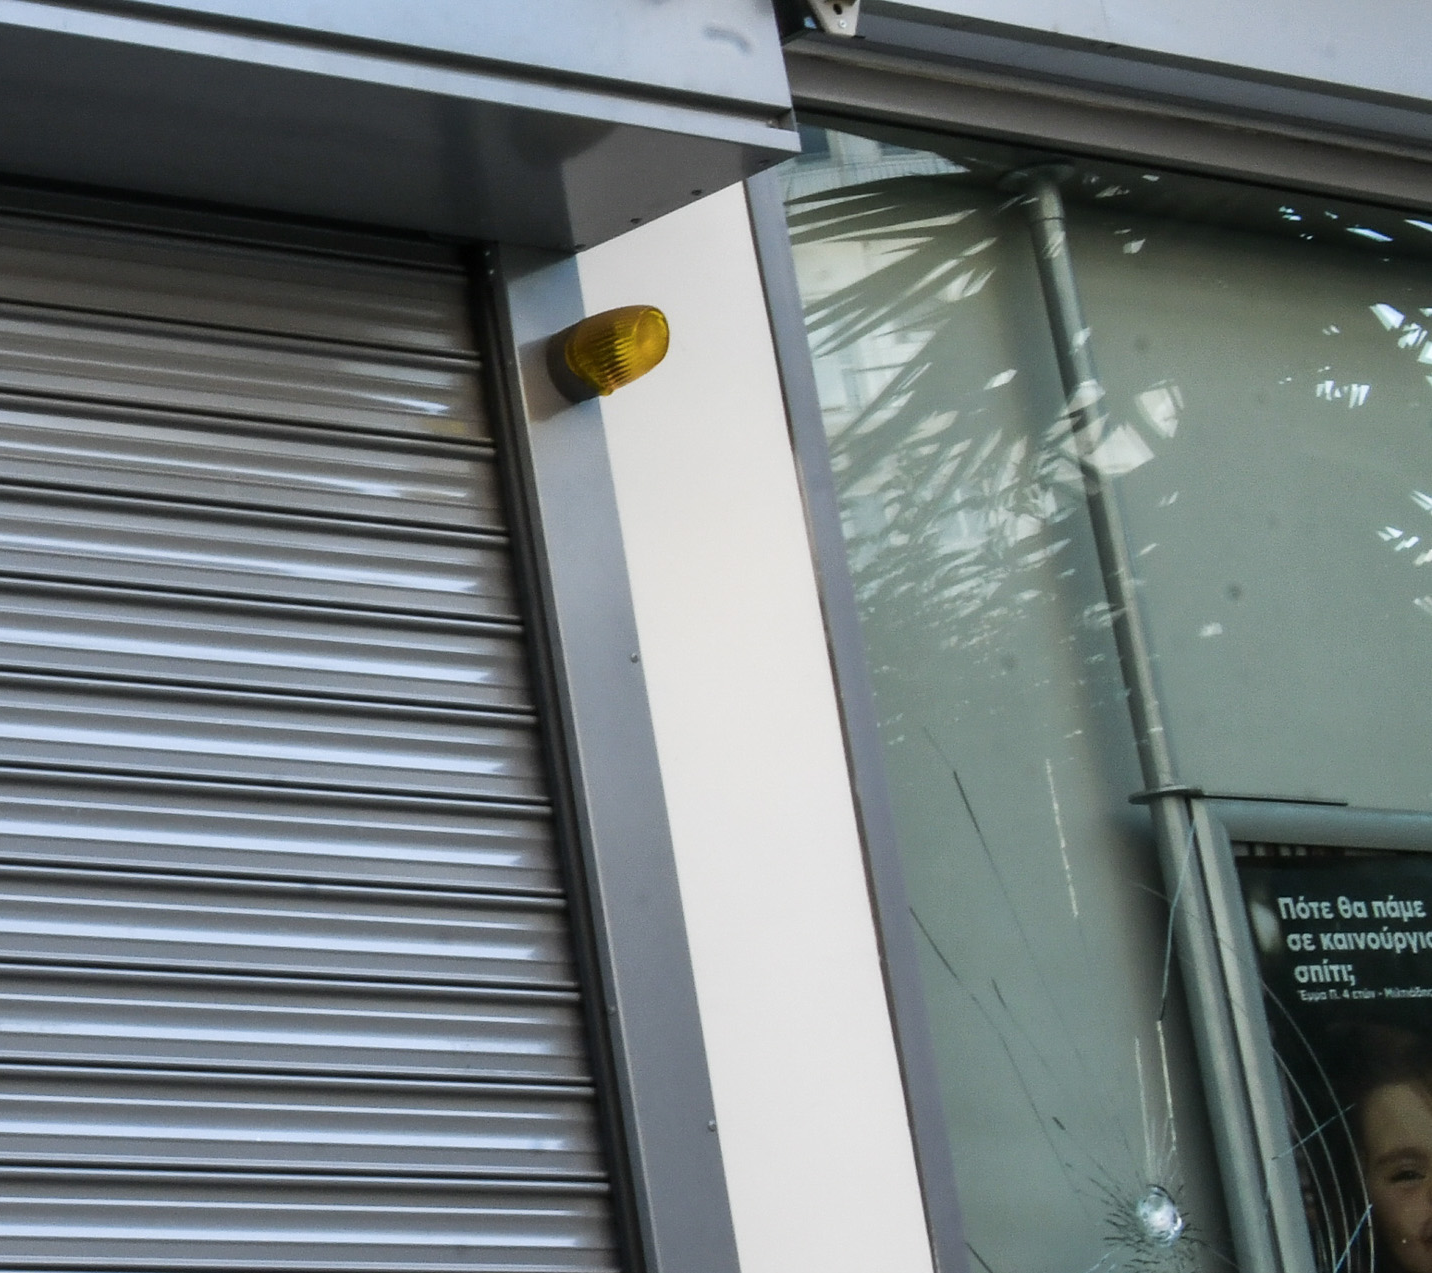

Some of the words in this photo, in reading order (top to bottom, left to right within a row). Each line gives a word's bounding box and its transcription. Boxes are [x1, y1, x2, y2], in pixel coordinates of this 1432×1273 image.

[1277, 895, 1334, 920] Πότε
[1337, 895, 1368, 919] θα
[1371, 894, 1427, 922] πάμε
[1286, 931, 1317, 952] σε
[1294, 958, 1356, 986] σπίτι;
